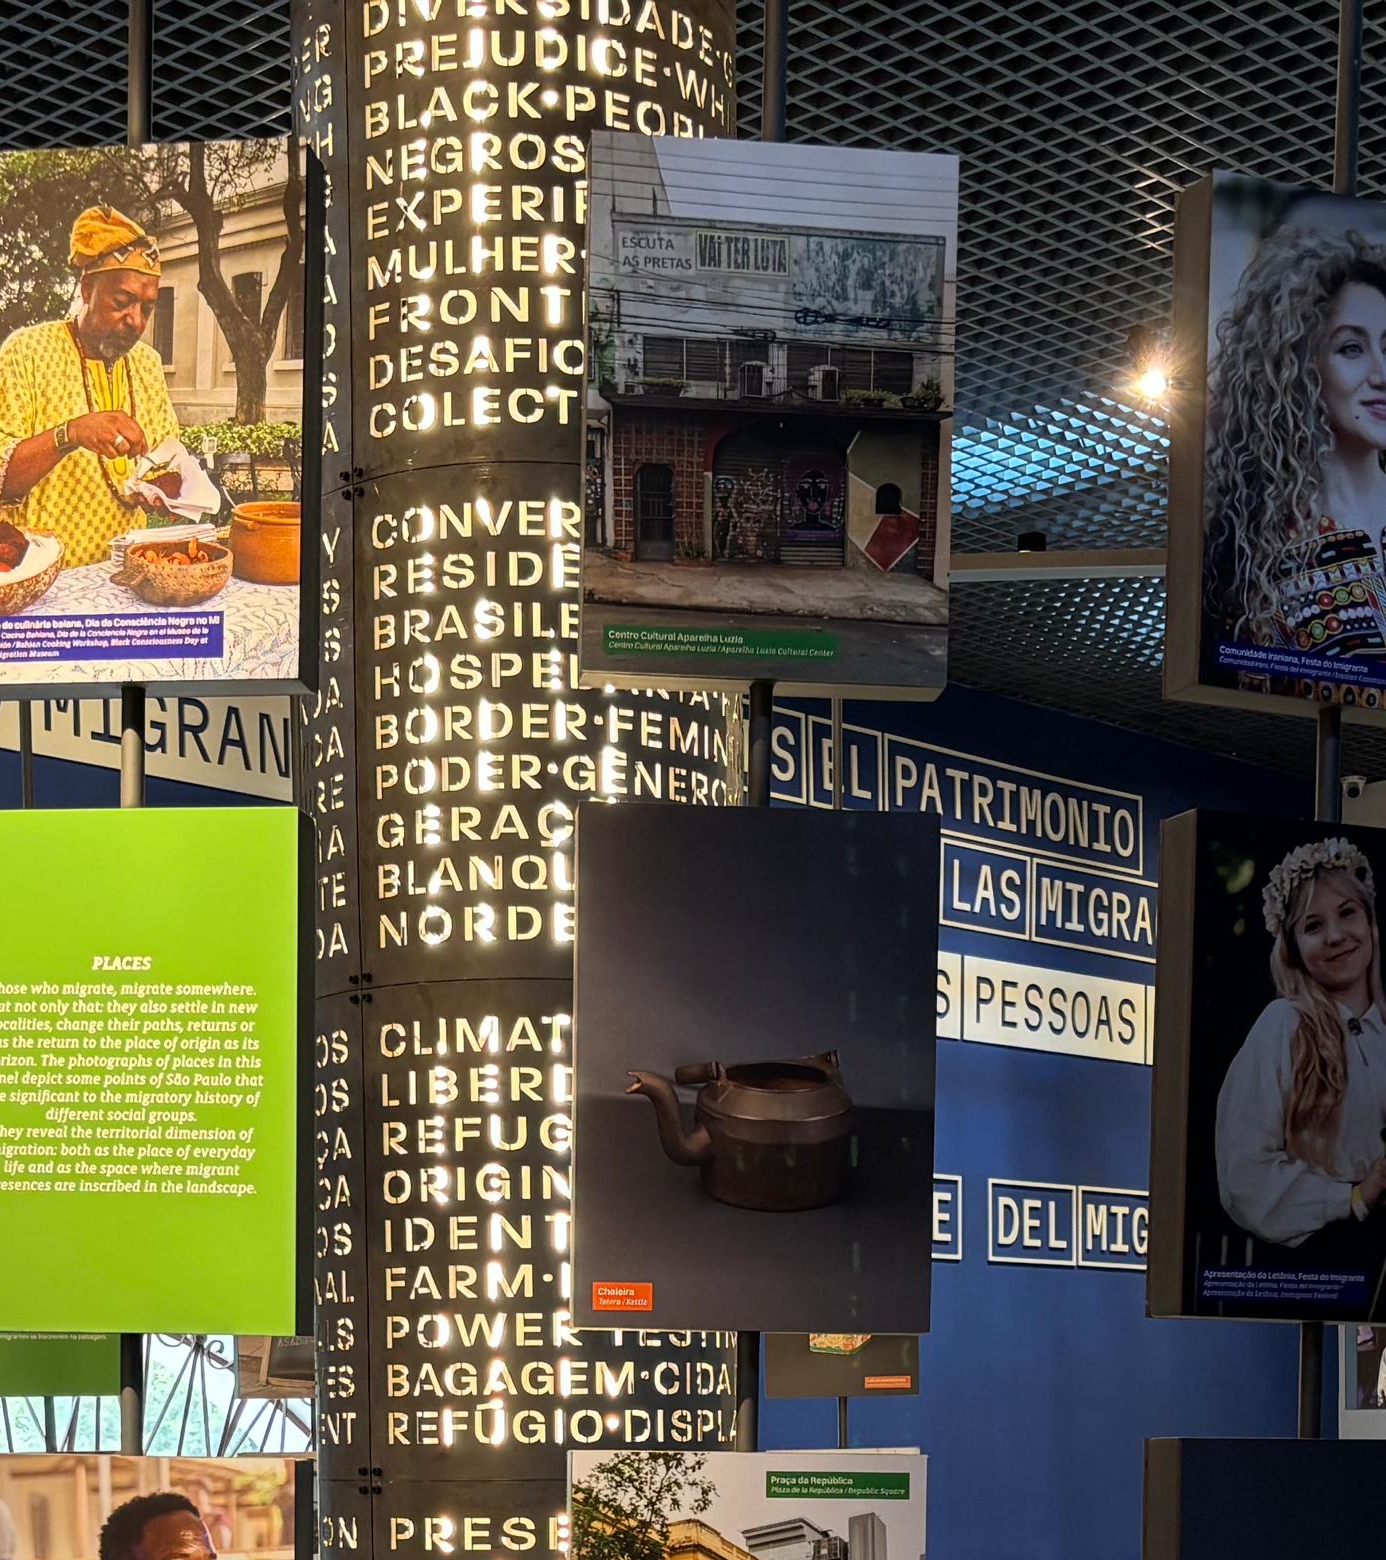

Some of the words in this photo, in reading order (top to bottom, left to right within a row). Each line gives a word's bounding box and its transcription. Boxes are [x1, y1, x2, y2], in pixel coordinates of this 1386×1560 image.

[622, 236, 675, 250] ESCUTA
[725, 236, 750, 271] TER
[754, 238, 787, 273] LUTA
[623, 256, 640, 267] AS
[644, 257, 692, 270] PRETAS
[369, 286, 585, 340] FRONT
[609, 630, 639, 640] Centro
[641, 631, 675, 641] Cultural
[895, 755, 1135, 858] PATRIMONIO
[952, 858, 1021, 922] LAS
[1040, 877, 1157, 946] MIGRA
[92, 956, 151, 970] PLACES
[31, 982, 59, 994] who
[62, 983, 117, 998] migrate,
[121, 983, 173, 998] migrate
[175, 982, 255, 995] somewhere.
[15, 1002, 37, 1012] not
[40, 1000, 69, 1016] only
[73, 1000, 104, 1012] that:
[107, 1000, 137, 1016] they
[140, 1000, 167, 1013] also
[170, 1000, 208, 1013] settle
[211, 1001, 225, 1013] in
[229, 1004, 257, 1013] new
[976, 976, 1136, 1046] PESSOAS
[57, 1018, 104, 1034] change
[107, 1018, 141, 1030] their
[143, 1018, 183, 1034] paths,
[187, 1020, 237, 1031] returns
[240, 1022, 255, 1032] or
[13, 1036, 34, 1048] the
[37, 1037, 79, 1048] return
[83, 1038, 97, 1048] to
[101, 1036, 122, 1048] the
[125, 1036, 161, 1052] place
[164, 1036, 178, 1052] of
[181, 1037, 220, 1053] origin
[224, 1040, 239, 1049] as
[243, 1038, 259, 1050] its
[41, 1054, 65, 1066] The
[68, 1054, 152, 1070] photographs
[155, 1055, 170, 1070] of
[172, 1055, 215, 1070] places
[218, 1056, 231, 1068] in
[236, 1055, 261, 1068] this
[21, 1072, 63, 1087] depict
[65, 1075, 101, 1084] some
[103, 1073, 146, 1088] points
[149, 1072, 165, 1088] of
[166, 1073, 190, 1085] São
[193, 1073, 231, 1086] Paulo
[235, 1073, 263, 1086] that
[9, 1090, 79, 1105] significant
[83, 1092, 97, 1102] to
[101, 1090, 122, 1103] the
[125, 1091, 192, 1106] migratory
[195, 1091, 243, 1107] history
[246, 1092, 261, 1107] of
[46, 1108, 104, 1123] different
[107, 1108, 145, 1120] social
[148, 1112, 197, 1124] groups.
[27, 1125, 67, 1138] reveal
[71, 1126, 93, 1138] the
[97, 1126, 161, 1139] territorial
[165, 1126, 235, 1140] dimension
[239, 1128, 254, 1142] of
[61, 1144, 91, 1156] both
[94, 1147, 109, 1156] as
[113, 1144, 134, 1156] the
[137, 1144, 173, 1159] place
[176, 1145, 191, 1160] of
[193, 1146, 255, 1161] everyday
[4, 1160, 25, 1175] life
[28, 1161, 53, 1174] and
[57, 1164, 71, 1174] as
[75, 1161, 97, 1174] the
[100, 1165, 137, 1177] space
[141, 1162, 183, 1175] where
[186, 1161, 239, 1178] migrant
[54, 1182, 76, 1191] are
[79, 1180, 141, 1192] inscribed
[144, 1180, 157, 1192] in
[162, 1180, 183, 1192] the
[187, 1180, 256, 1196] landscape.
[998, 1196, 1068, 1249] DEL
[598, 1287, 635, 1296] Chaleira
[771, 1476, 796, 1485] Praça
[810, 1476, 853, 1486] República
